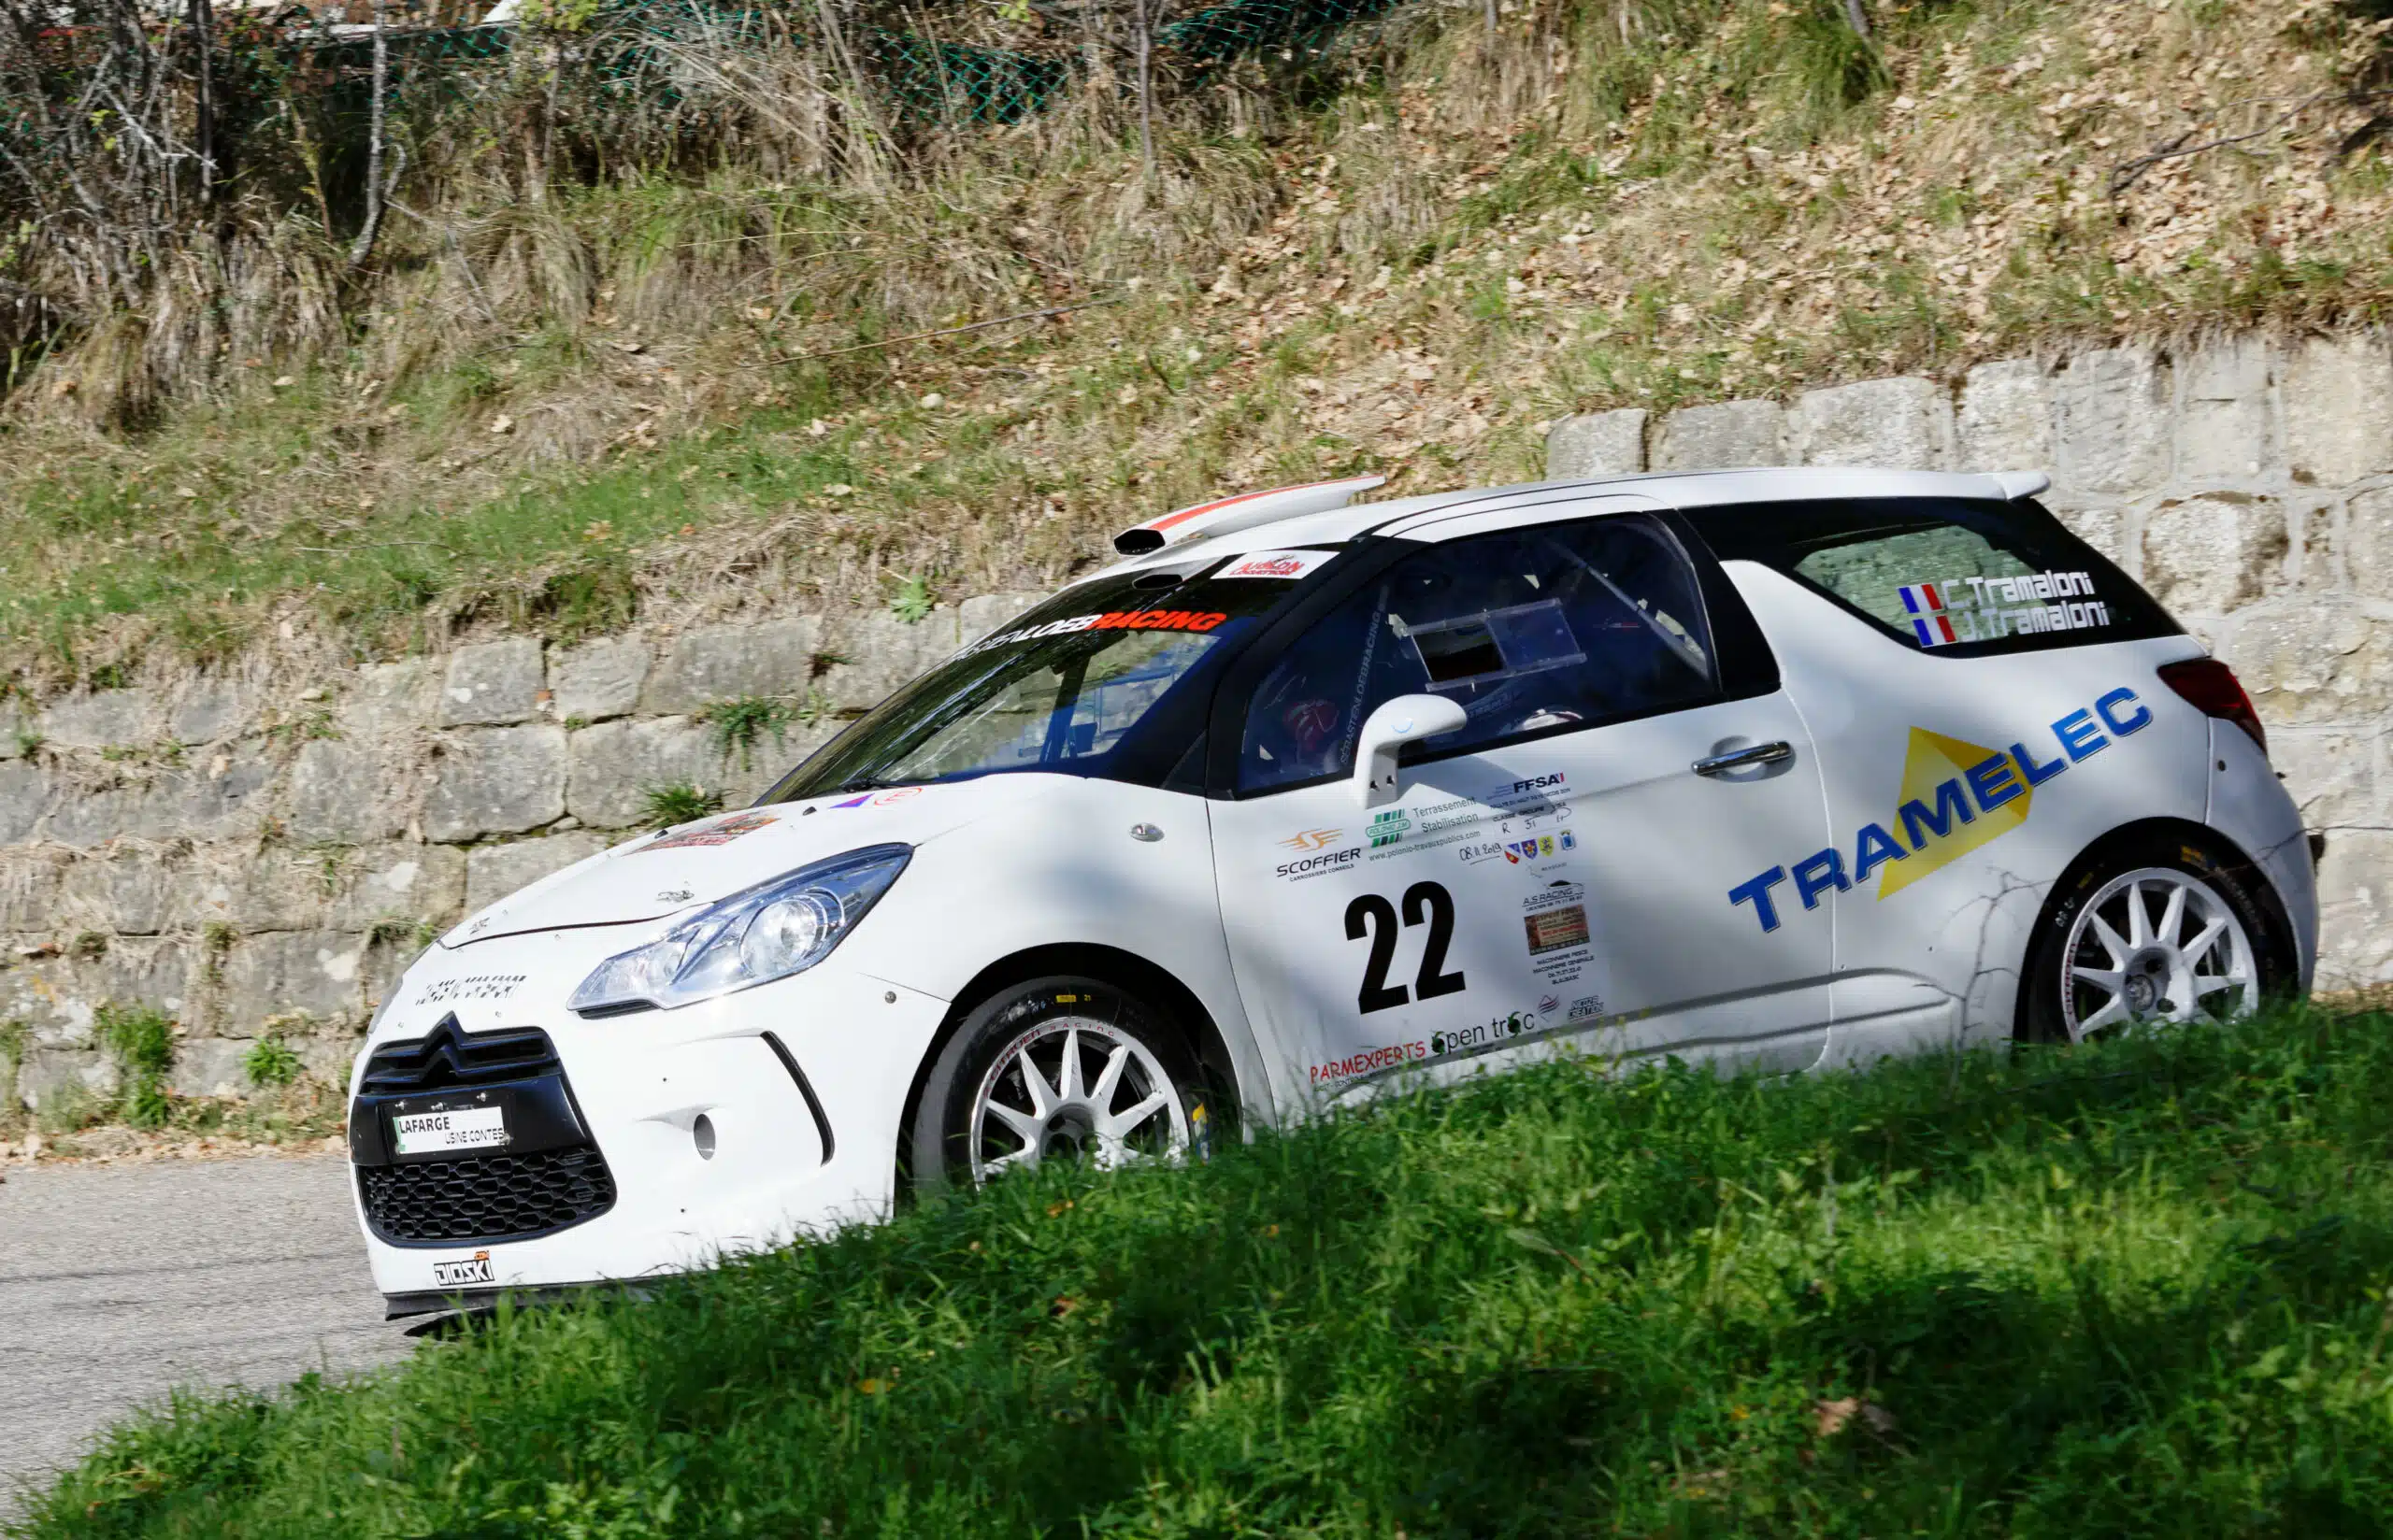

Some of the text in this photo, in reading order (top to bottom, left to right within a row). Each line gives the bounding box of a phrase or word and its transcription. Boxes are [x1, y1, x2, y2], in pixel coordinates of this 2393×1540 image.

[1513, 774, 1560, 792] FFSA
[1412, 796, 1476, 819] Terrassement
[1727, 686, 2153, 934] TRAMELEC
[1421, 812, 1479, 834] Stabilisation
[1277, 848, 1361, 877] SCOFFIER
[1344, 880, 1466, 1015] 22
[1311, 1041, 1426, 1083] PARMEXPERTS
[399, 1117, 450, 1134] LAFARGE
[445, 1128, 504, 1144] USINE CONTES
